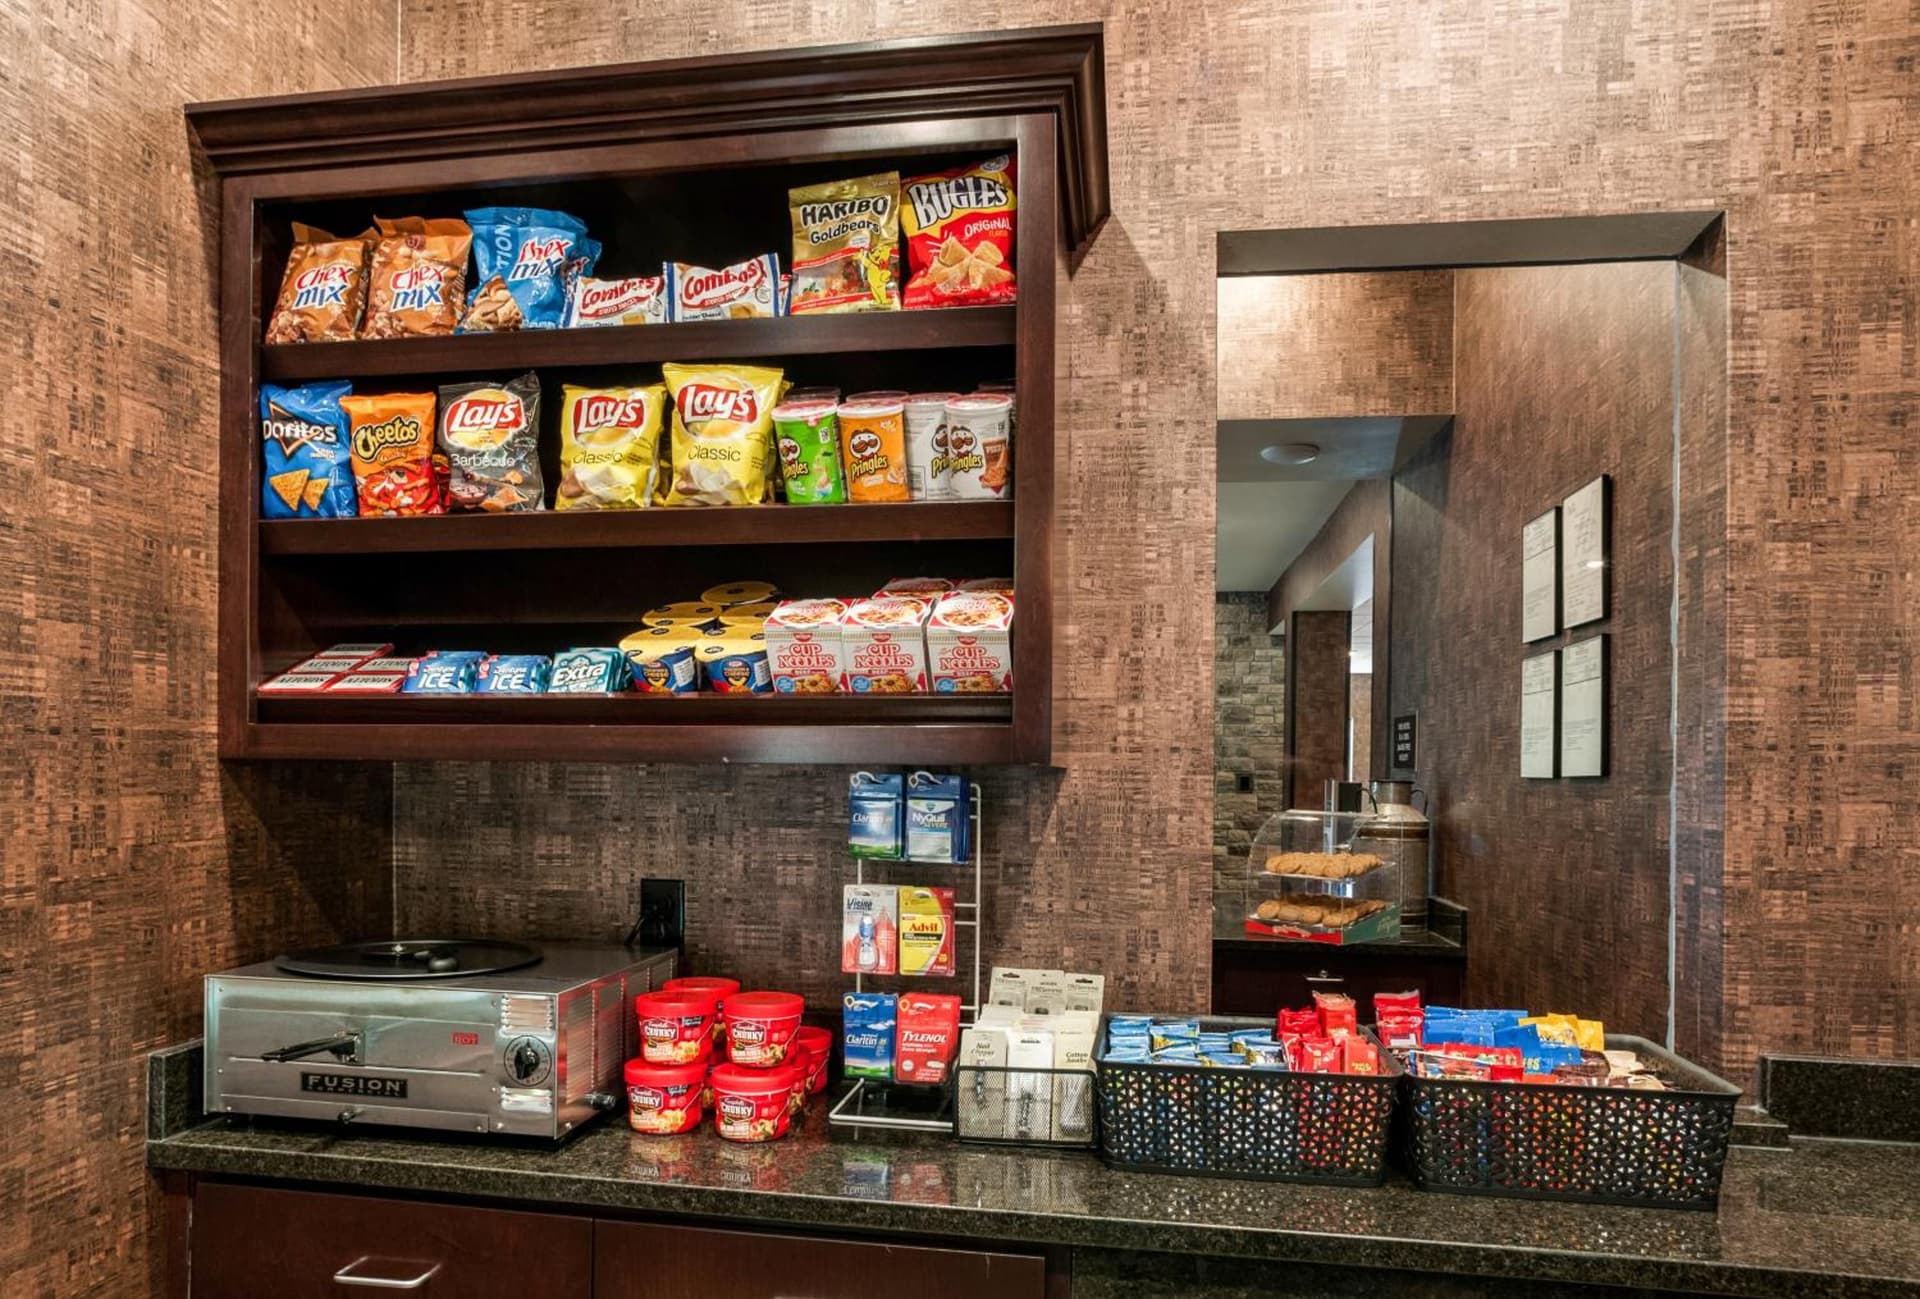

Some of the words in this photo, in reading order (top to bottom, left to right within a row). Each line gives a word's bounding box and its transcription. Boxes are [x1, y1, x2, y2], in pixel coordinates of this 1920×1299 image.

[801, 195, 890, 227] HARIBO
[908, 177, 1008, 230] BUGLES
[810, 219, 880, 245] Goldbears
[964, 217, 1012, 239] ORIGINAL
[297, 266, 354, 290] Chex
[392, 265, 446, 290] Chex
[685, 262, 757, 299] Combos
[263, 420, 337, 442] Doritos
[354, 416, 419, 460] Cheetos
[572, 450, 624, 464] Classic
[688, 446, 741, 462] Classic
[851, 455, 888, 481] Pringles
[790, 644, 822, 656] CUP
[867, 644, 901, 656] CUP
[953, 647, 986, 659] CUP
[777, 655, 836, 668] NOODLES
[855, 655, 914, 668] NOODLES
[940, 658, 1000, 670] NOODLES
[552, 661, 606, 687] Extra
[912, 813, 946, 824] NyQuil
[909, 922, 938, 932] Advil
[846, 1034, 878, 1046] Claritin
[901, 1030, 947, 1044] TYLENOL
[308, 1075, 401, 1091] FUSION
